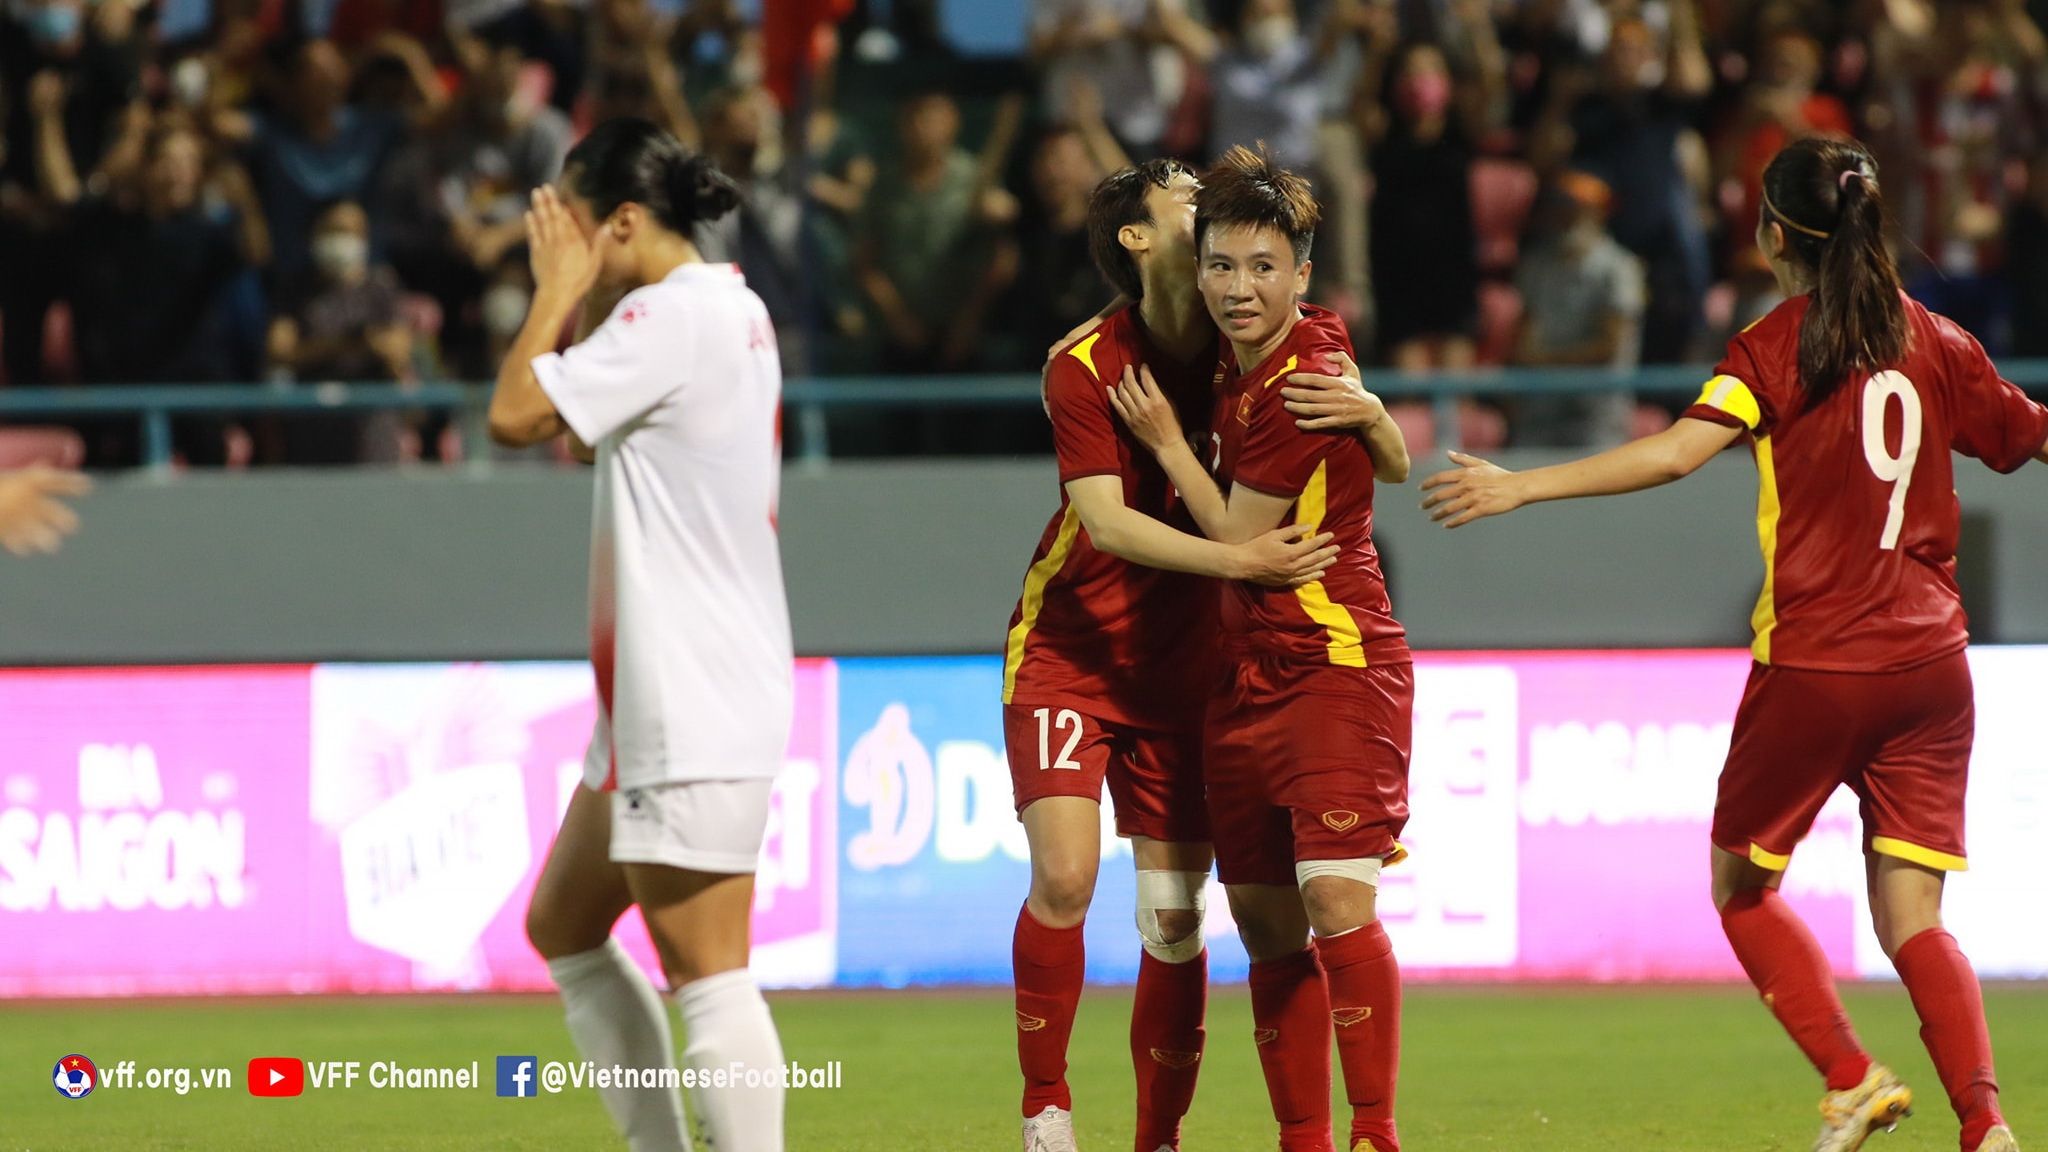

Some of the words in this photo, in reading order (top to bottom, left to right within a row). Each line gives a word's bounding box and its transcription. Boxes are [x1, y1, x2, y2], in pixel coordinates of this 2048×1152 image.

[1863, 369, 1922, 550] 9
[1034, 707, 1084, 770] 12
[0, 807, 246, 911] SAIGON
